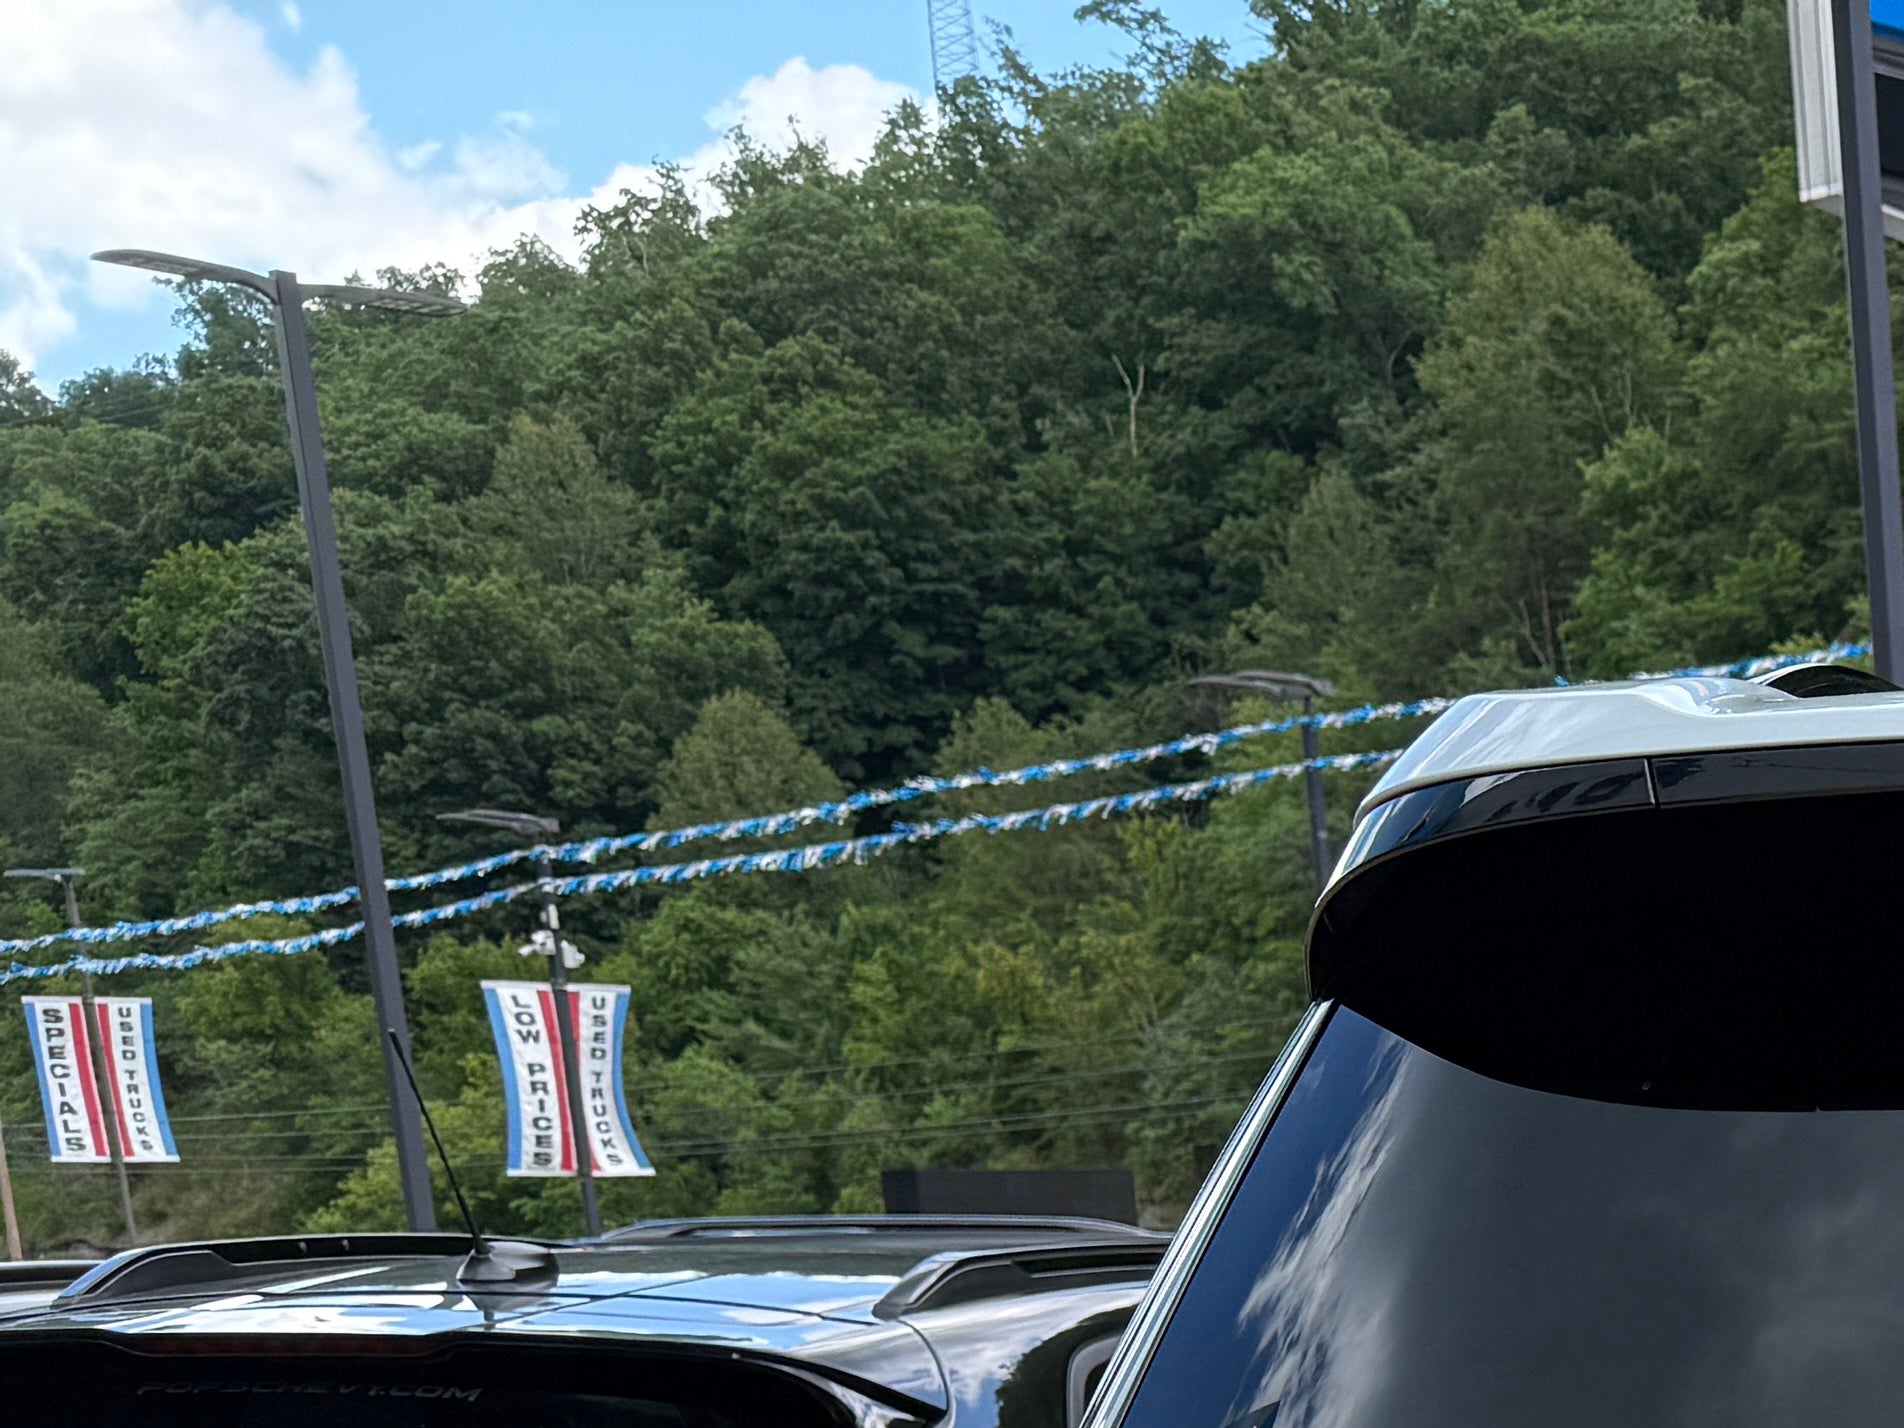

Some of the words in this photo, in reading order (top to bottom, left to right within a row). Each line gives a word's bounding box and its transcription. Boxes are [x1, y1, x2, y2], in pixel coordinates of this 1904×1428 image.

[118, 1007, 137, 1061] USED
[590, 995, 608, 1060] USED
[41, 1008, 87, 1152] SPECIALS
[124, 1069, 154, 1151] TRUCKS
[510, 994, 540, 1043] LOW
[526, 1063, 554, 1167] PRICES
[591, 1071, 624, 1166] TRUCKS
